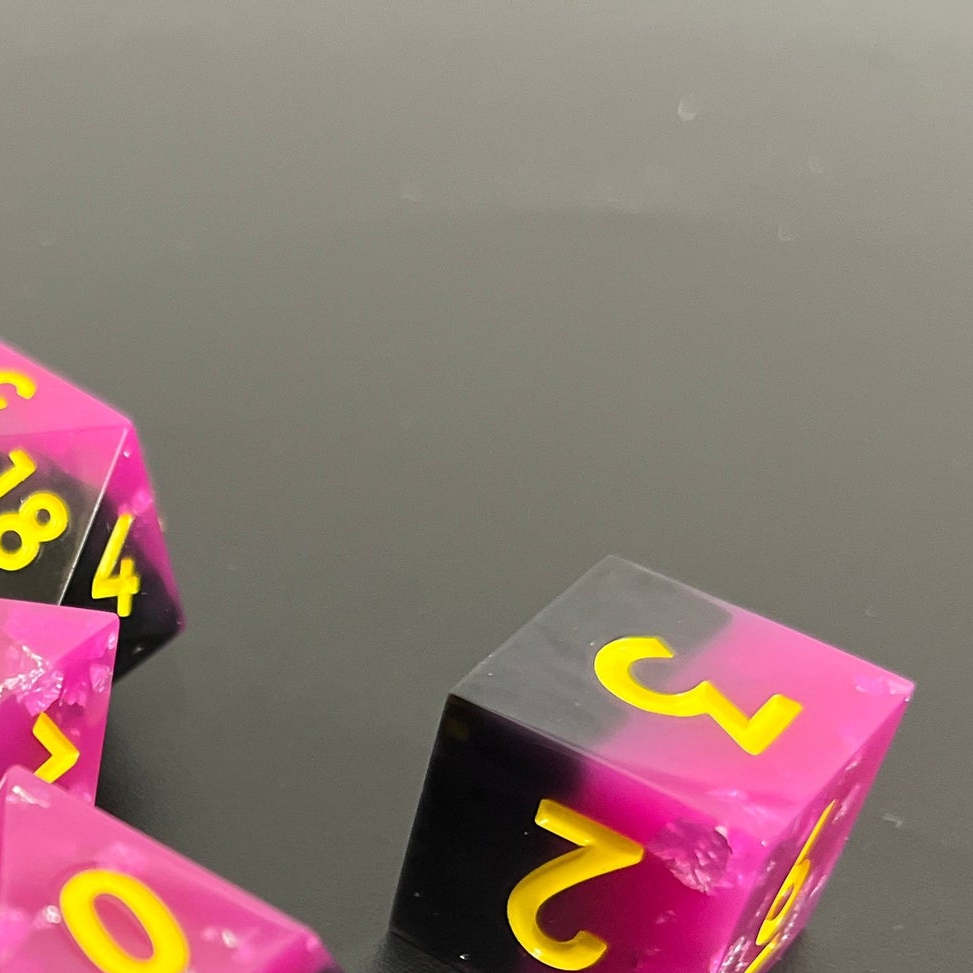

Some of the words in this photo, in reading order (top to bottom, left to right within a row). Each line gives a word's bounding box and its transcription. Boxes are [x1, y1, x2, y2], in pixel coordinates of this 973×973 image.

[90, 511, 142, 618] 4
[594, 635, 804, 756] 3
[506, 798, 645, 972] 2
